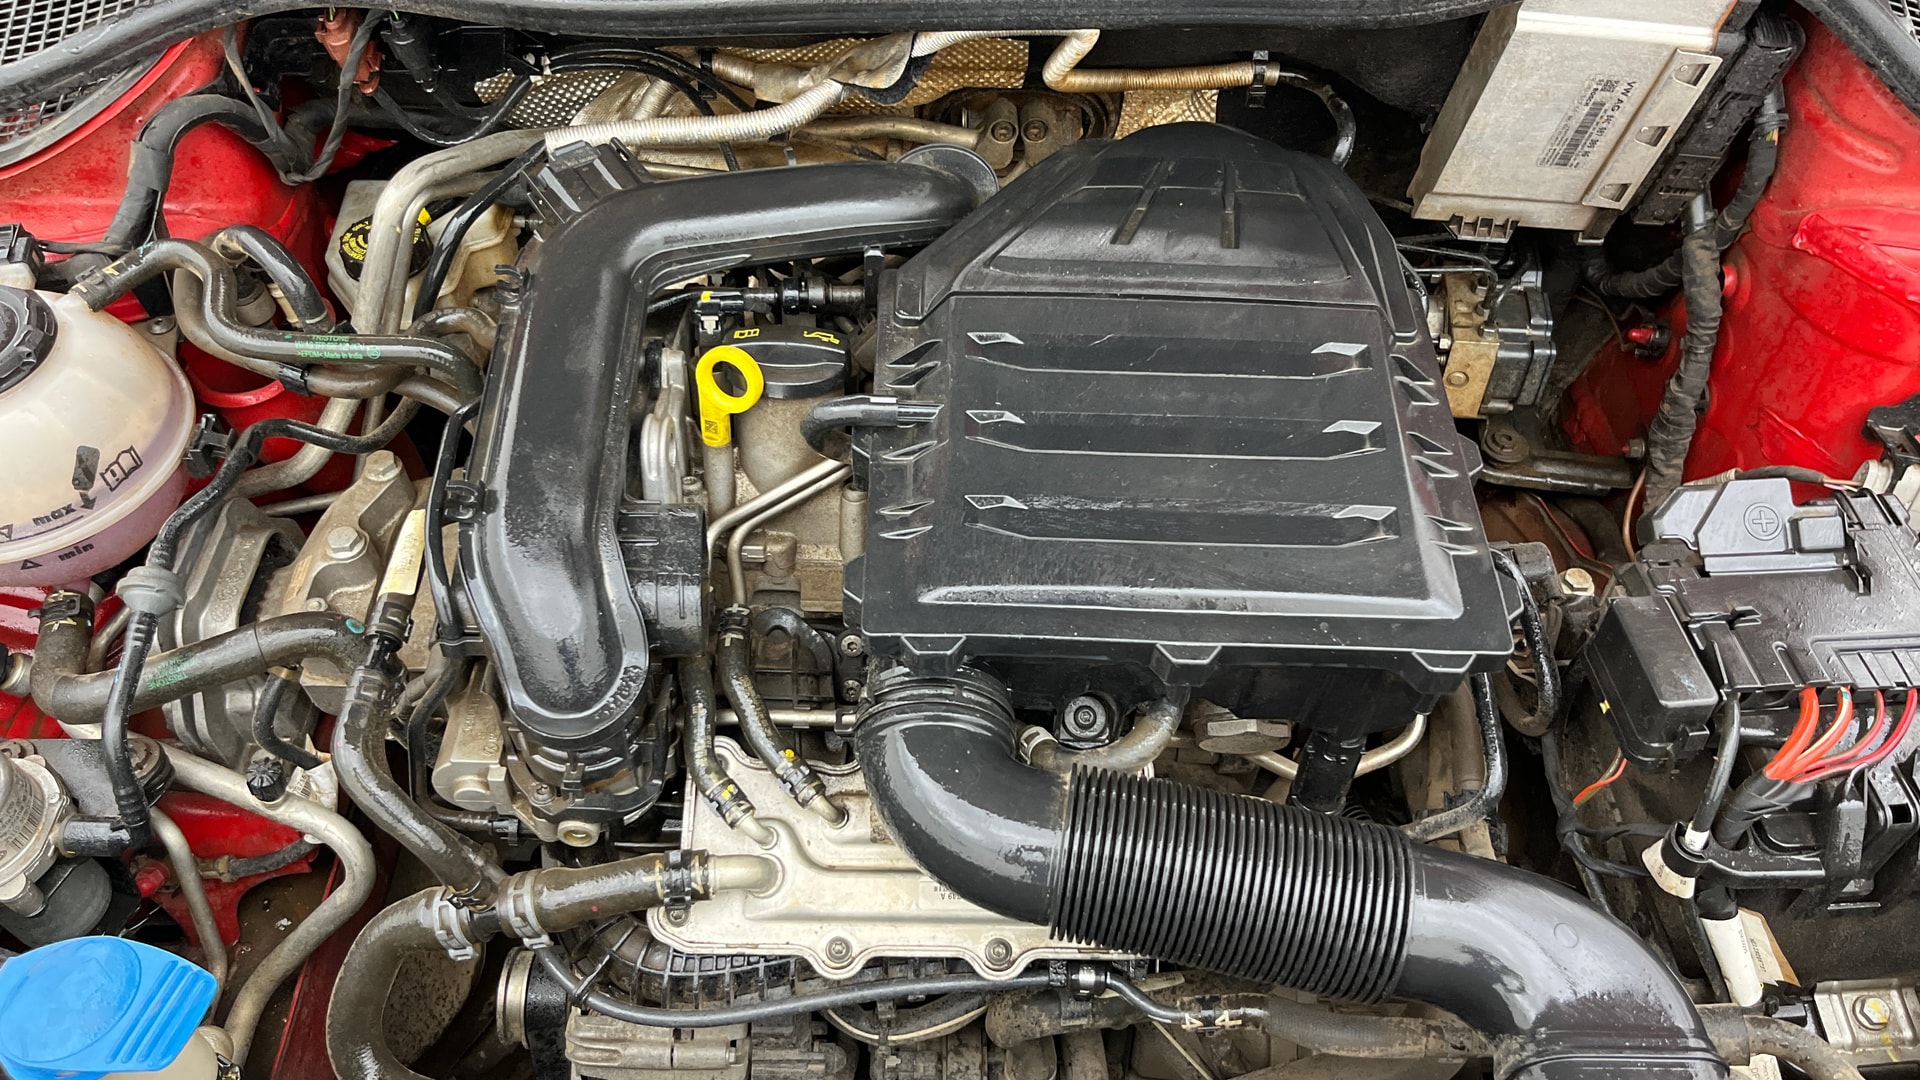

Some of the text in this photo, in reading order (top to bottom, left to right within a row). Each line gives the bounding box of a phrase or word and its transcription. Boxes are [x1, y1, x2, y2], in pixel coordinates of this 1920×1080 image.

[1621, 80, 1636, 97] VW
[1611, 98, 1624, 112] AG
[32, 503, 77, 526] max
[58, 543, 94, 561] min
[147, 670, 188, 690] TRISTONE
